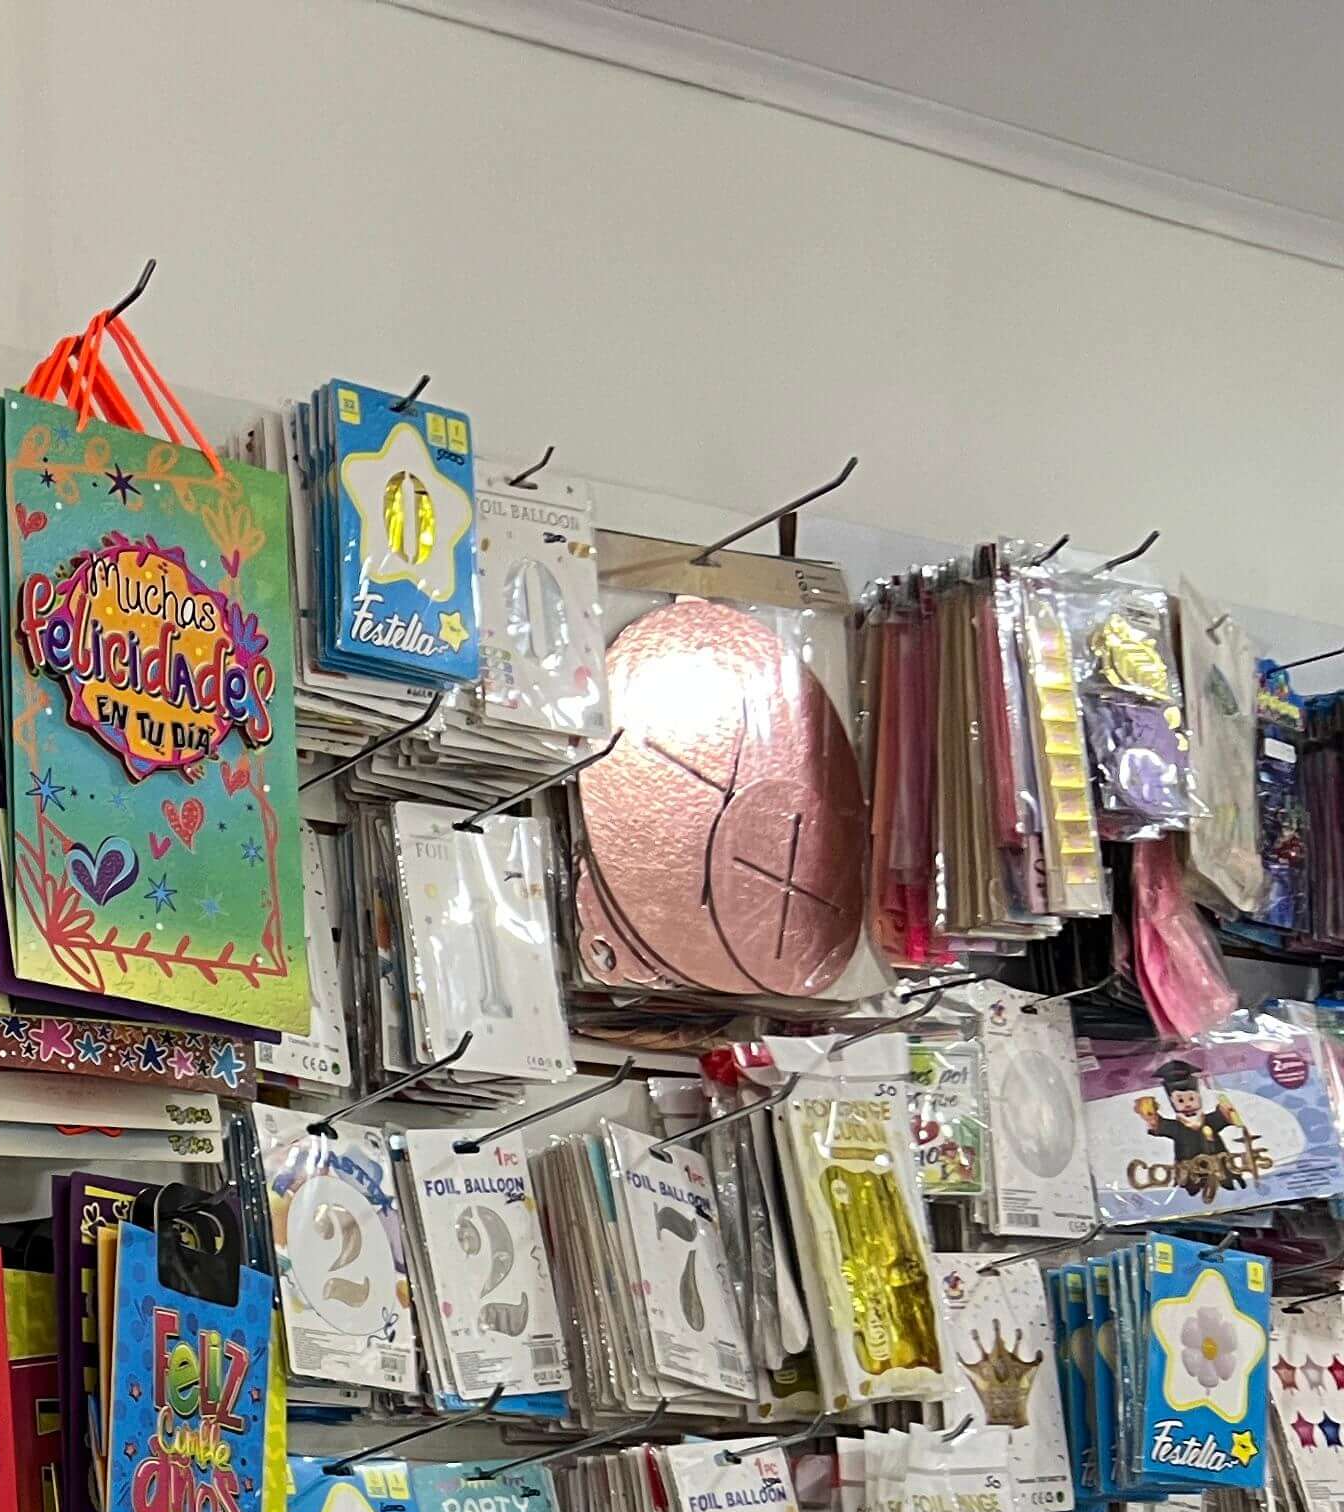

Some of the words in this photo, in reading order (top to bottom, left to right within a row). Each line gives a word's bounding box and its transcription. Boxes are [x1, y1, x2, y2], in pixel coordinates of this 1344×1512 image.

[351, 593, 444, 658] Festella
[96, 697, 129, 731] EN
[136, 711, 166, 749] TU
[171, 719, 216, 754] DÍA
[423, 1177, 459, 1197] FOIL
[463, 1175, 526, 1196] BALLOON
[625, 1169, 657, 1193] FOIL
[312, 1203, 370, 1308] 2
[455, 1205, 530, 1338] 2
[754, 1456, 780, 1478] 1PC
[1151, 1418, 1239, 1471] Festella
[688, 1490, 722, 1512] FOIL
[725, 1485, 787, 1510] BALLOON
